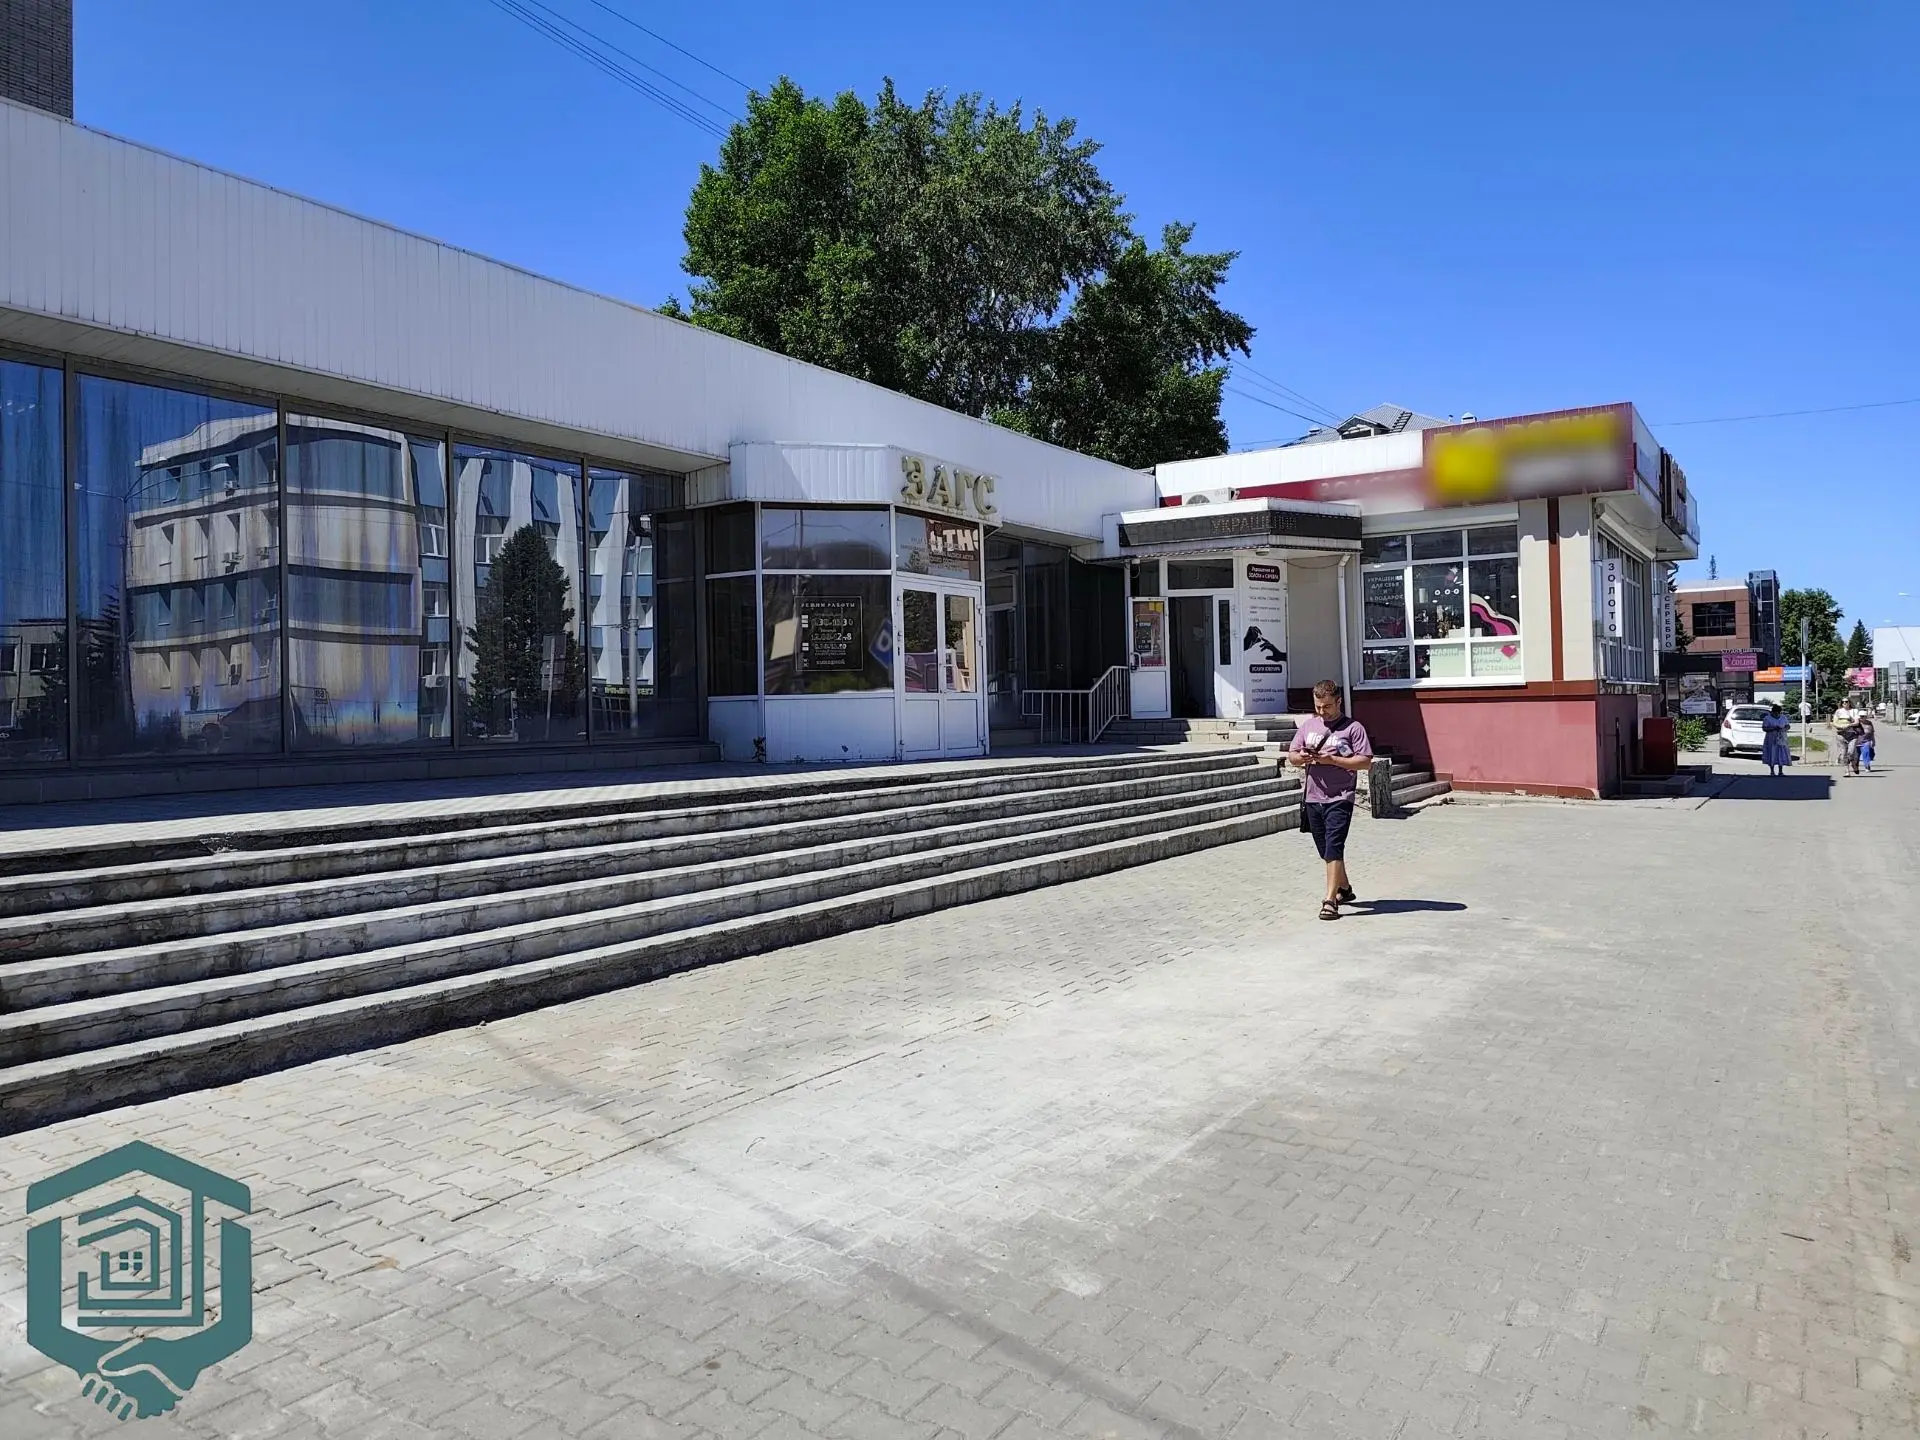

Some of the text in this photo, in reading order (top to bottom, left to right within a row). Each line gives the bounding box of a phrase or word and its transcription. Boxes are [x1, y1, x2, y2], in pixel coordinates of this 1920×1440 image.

[901, 456, 997, 515] ЗАГС
[1607, 562, 1617, 632] ЗОЛОТО
[1664, 595, 1672, 648] СЕРЕБРО
